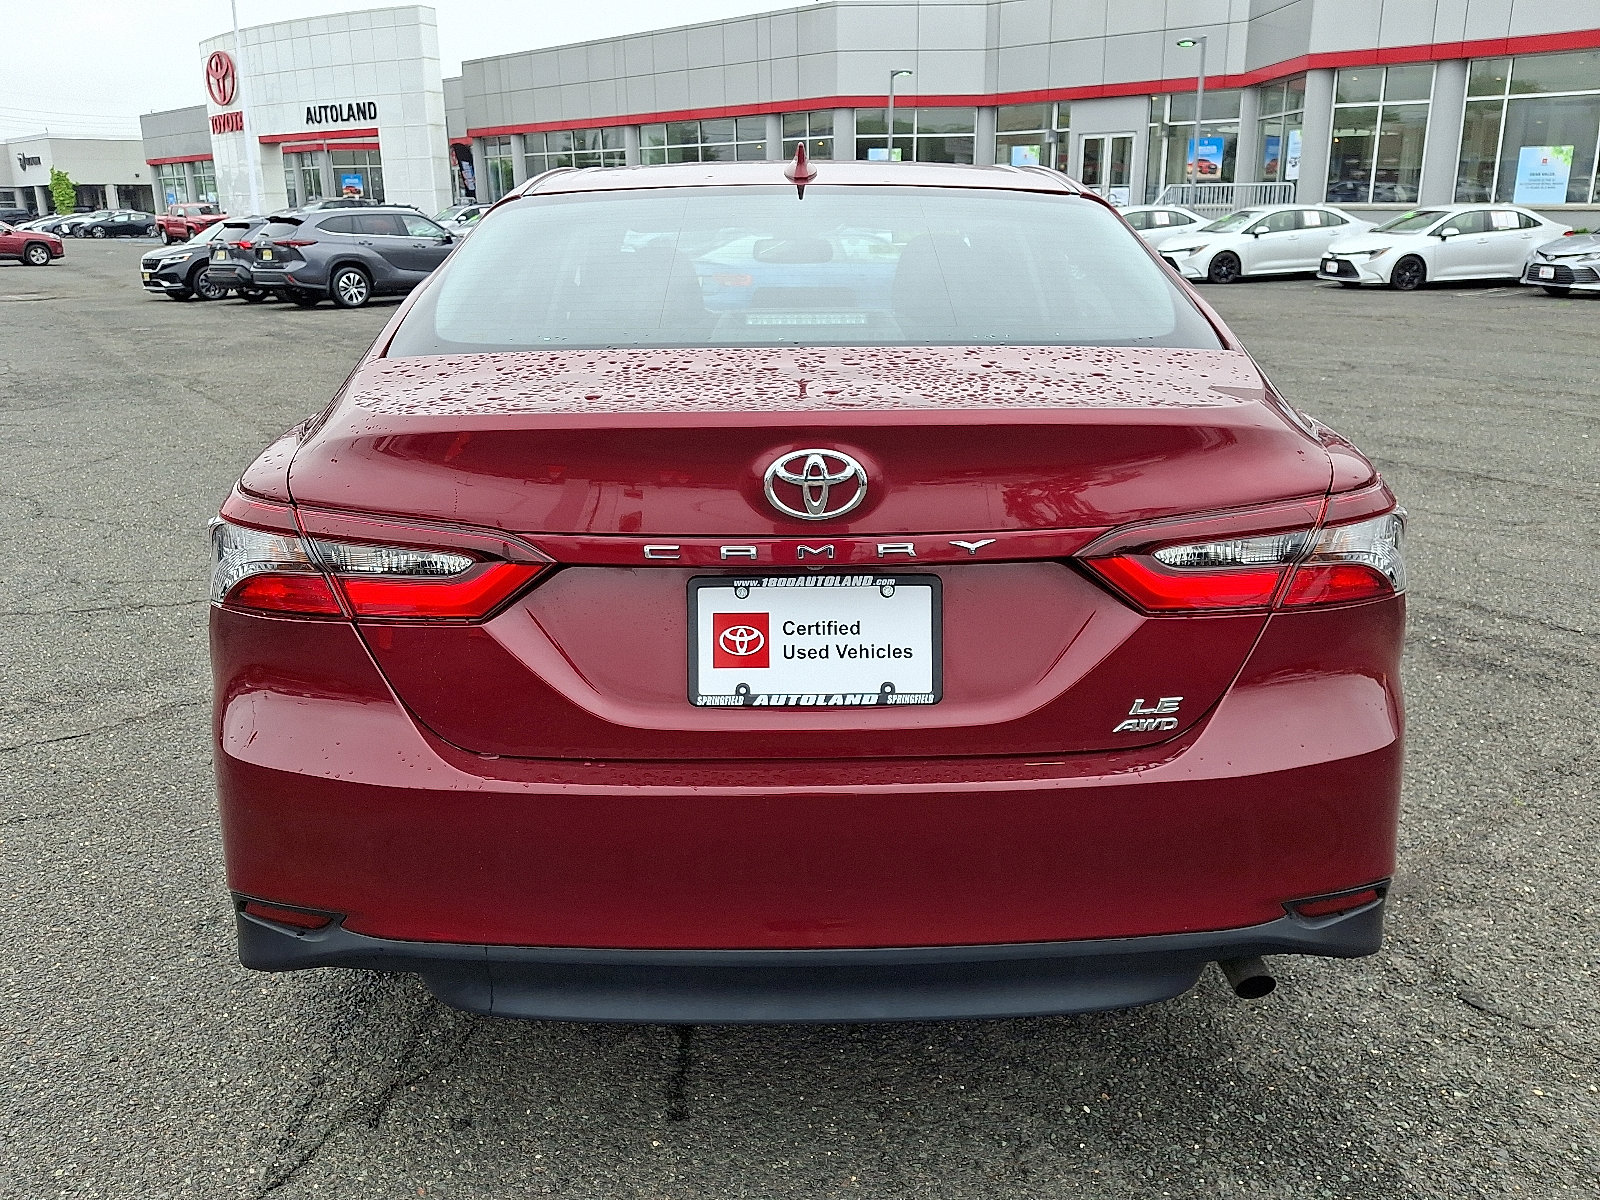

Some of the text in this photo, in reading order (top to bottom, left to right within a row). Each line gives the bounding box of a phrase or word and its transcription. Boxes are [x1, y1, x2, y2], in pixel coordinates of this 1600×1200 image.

[306, 101, 377, 124] AUTOLAND
[643, 538, 997, 560] CAMRY
[733, 576, 896, 588] www.1800AUTOLAND.com
[782, 620, 861, 636] Certified
[782, 643, 914, 660] Used Vehicles
[696, 693, 935, 706] SPRINGFIELD AUTOLAND SPRINGFIELD
[1128, 696, 1184, 716] LE
[1112, 717, 1179, 733] AWD
